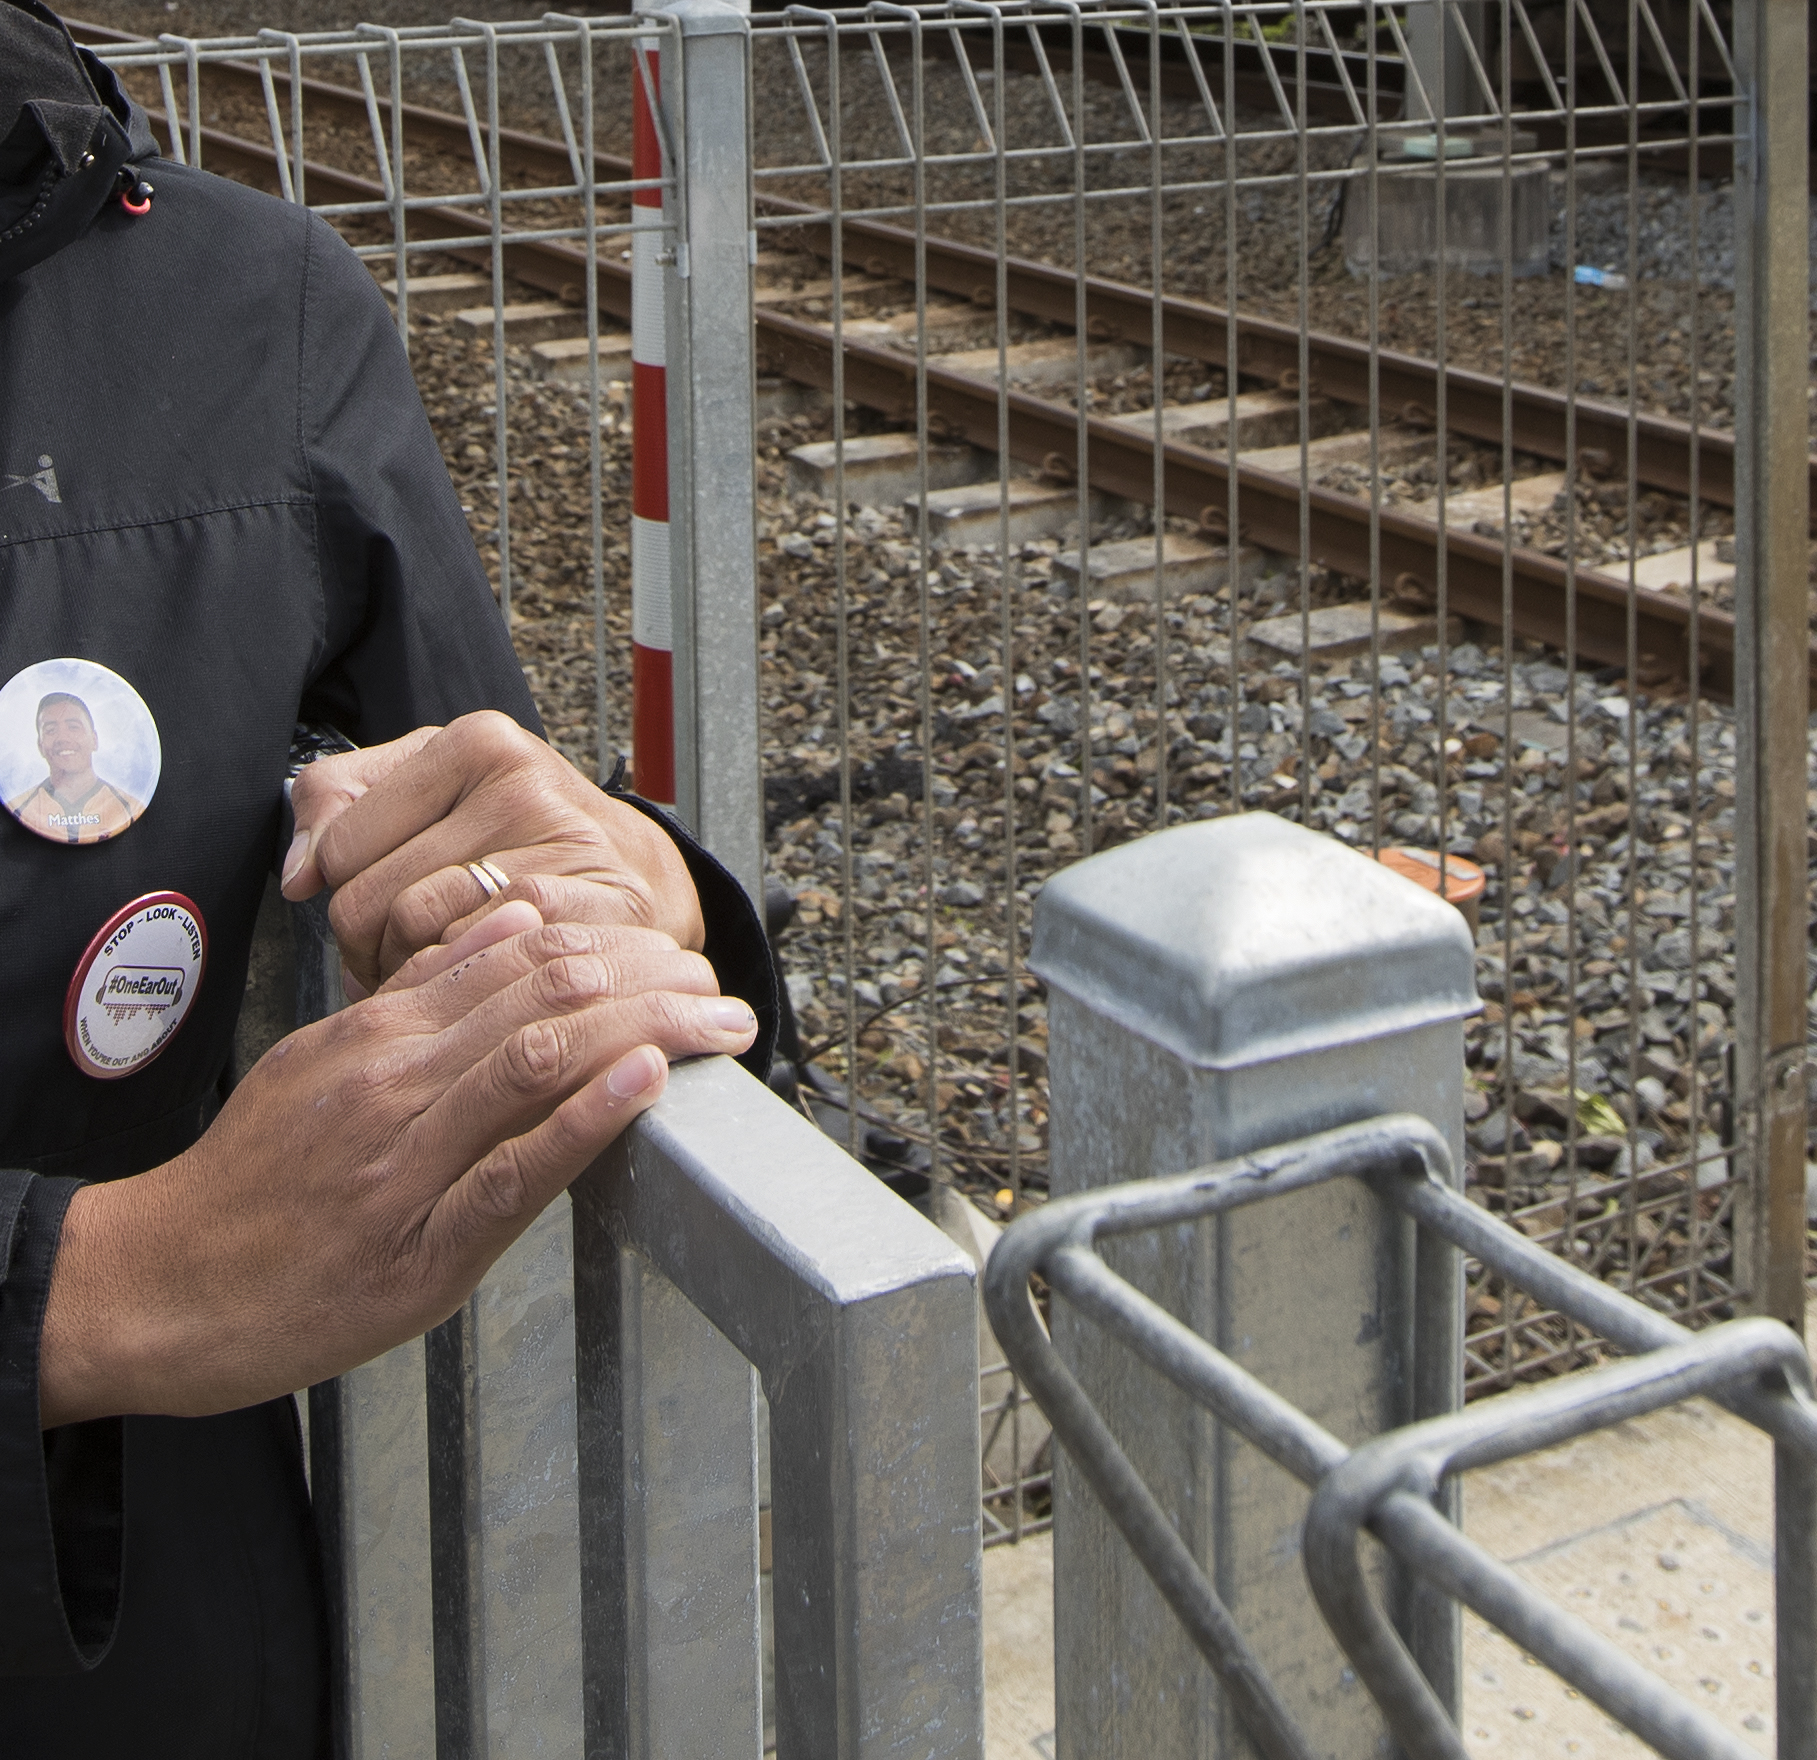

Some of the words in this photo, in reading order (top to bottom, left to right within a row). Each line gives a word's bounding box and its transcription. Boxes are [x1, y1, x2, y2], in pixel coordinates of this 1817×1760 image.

[47, 811, 101, 827] Matthes
[104, 920, 135, 956] STOP
[145, 907, 178, 923] LOOK
[181, 916, 201, 961] LISTEN
[107, 973, 178, 995] #OneEarOut
[80, 1016, 92, 1047] WHEN
[88, 1043, 112, 1066] YOU'RE
[112, 1056, 131, 1067] OUT
[131, 1047, 150, 1063] AND
[150, 1017, 178, 1051] ABOUT
